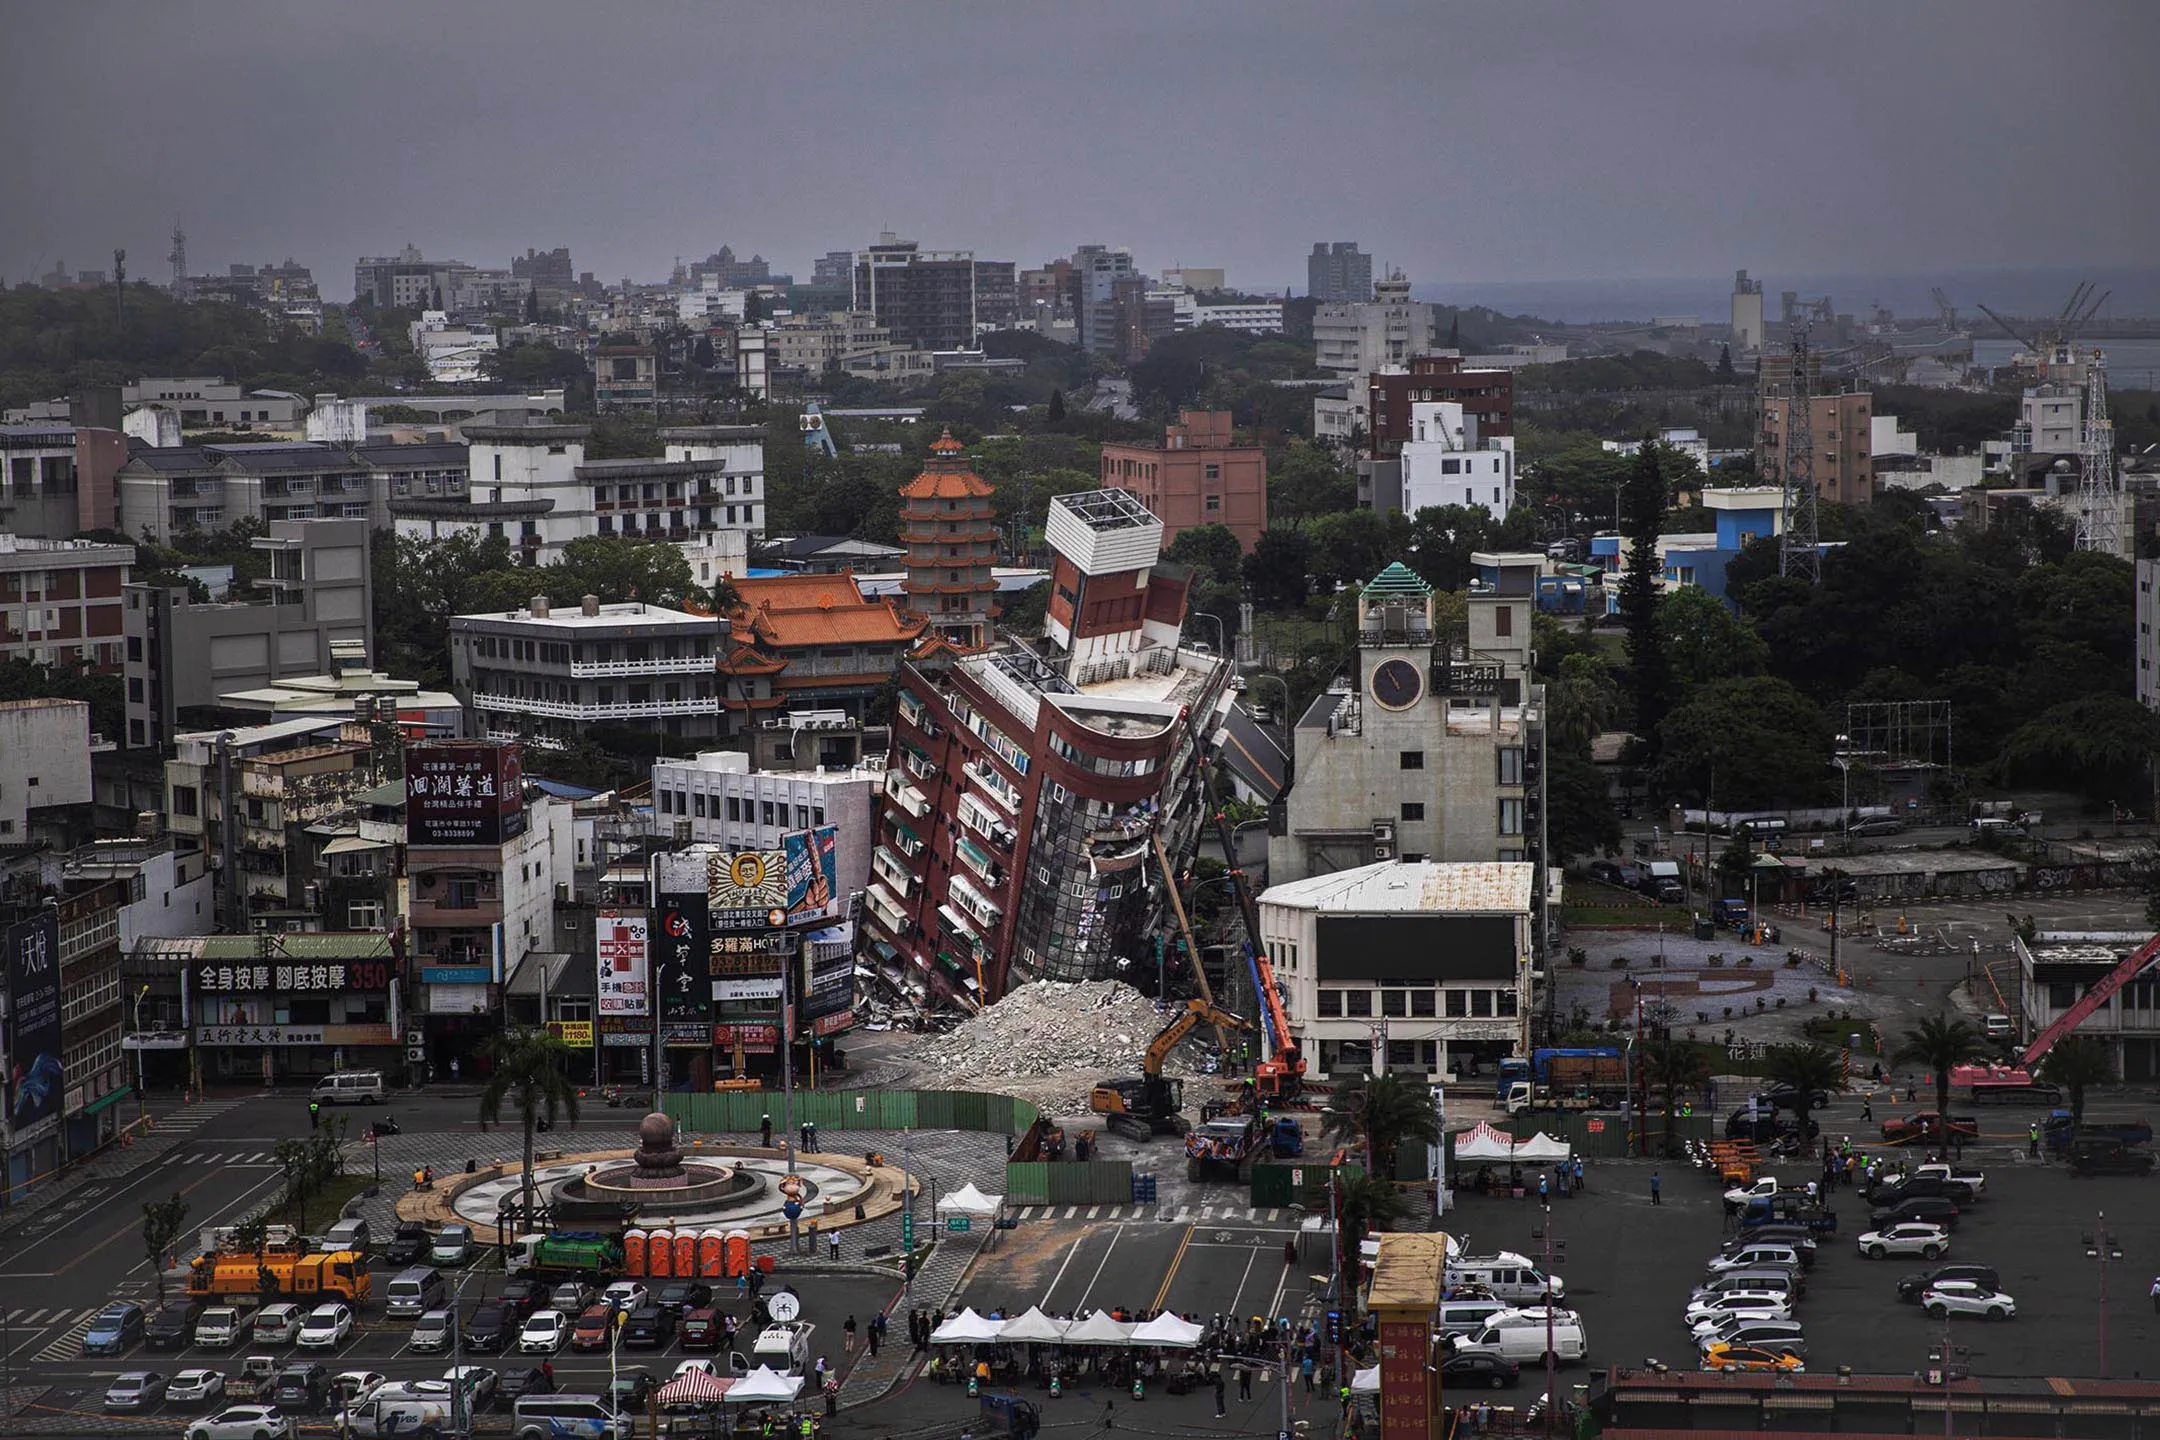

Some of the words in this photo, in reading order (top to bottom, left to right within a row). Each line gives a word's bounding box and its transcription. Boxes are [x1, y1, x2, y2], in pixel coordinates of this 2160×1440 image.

[409, 773, 496, 797] 洄瀾薯道
[199, 965, 270, 990] 全身按摩
[276, 964, 346, 990] 腳底按摩
[351, 963, 387, 989] 350
